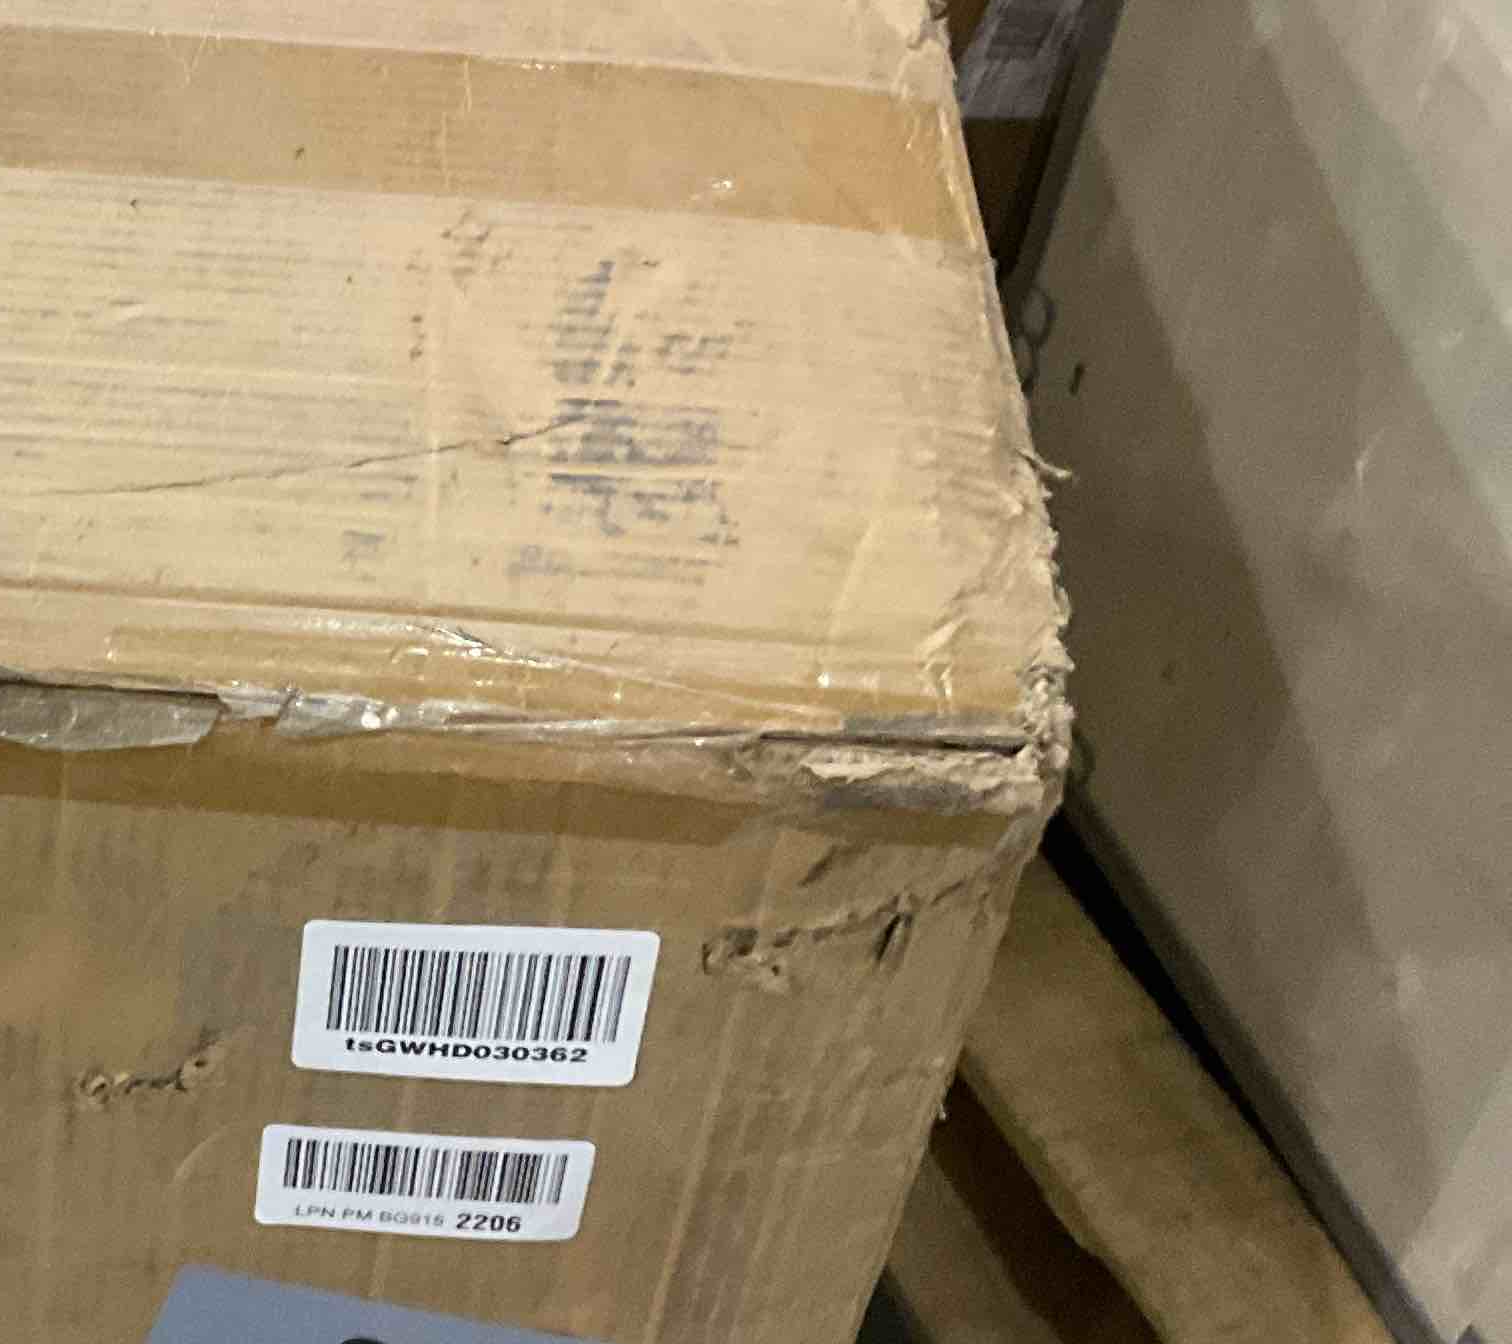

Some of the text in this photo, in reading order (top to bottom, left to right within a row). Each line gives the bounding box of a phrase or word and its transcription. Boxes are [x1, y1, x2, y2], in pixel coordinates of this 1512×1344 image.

[345, 1036, 589, 1064] tsGWHD030362
[294, 1204, 336, 1219] LPN
[341, 1208, 373, 1222] PM
[455, 1212, 522, 1233] 2206
